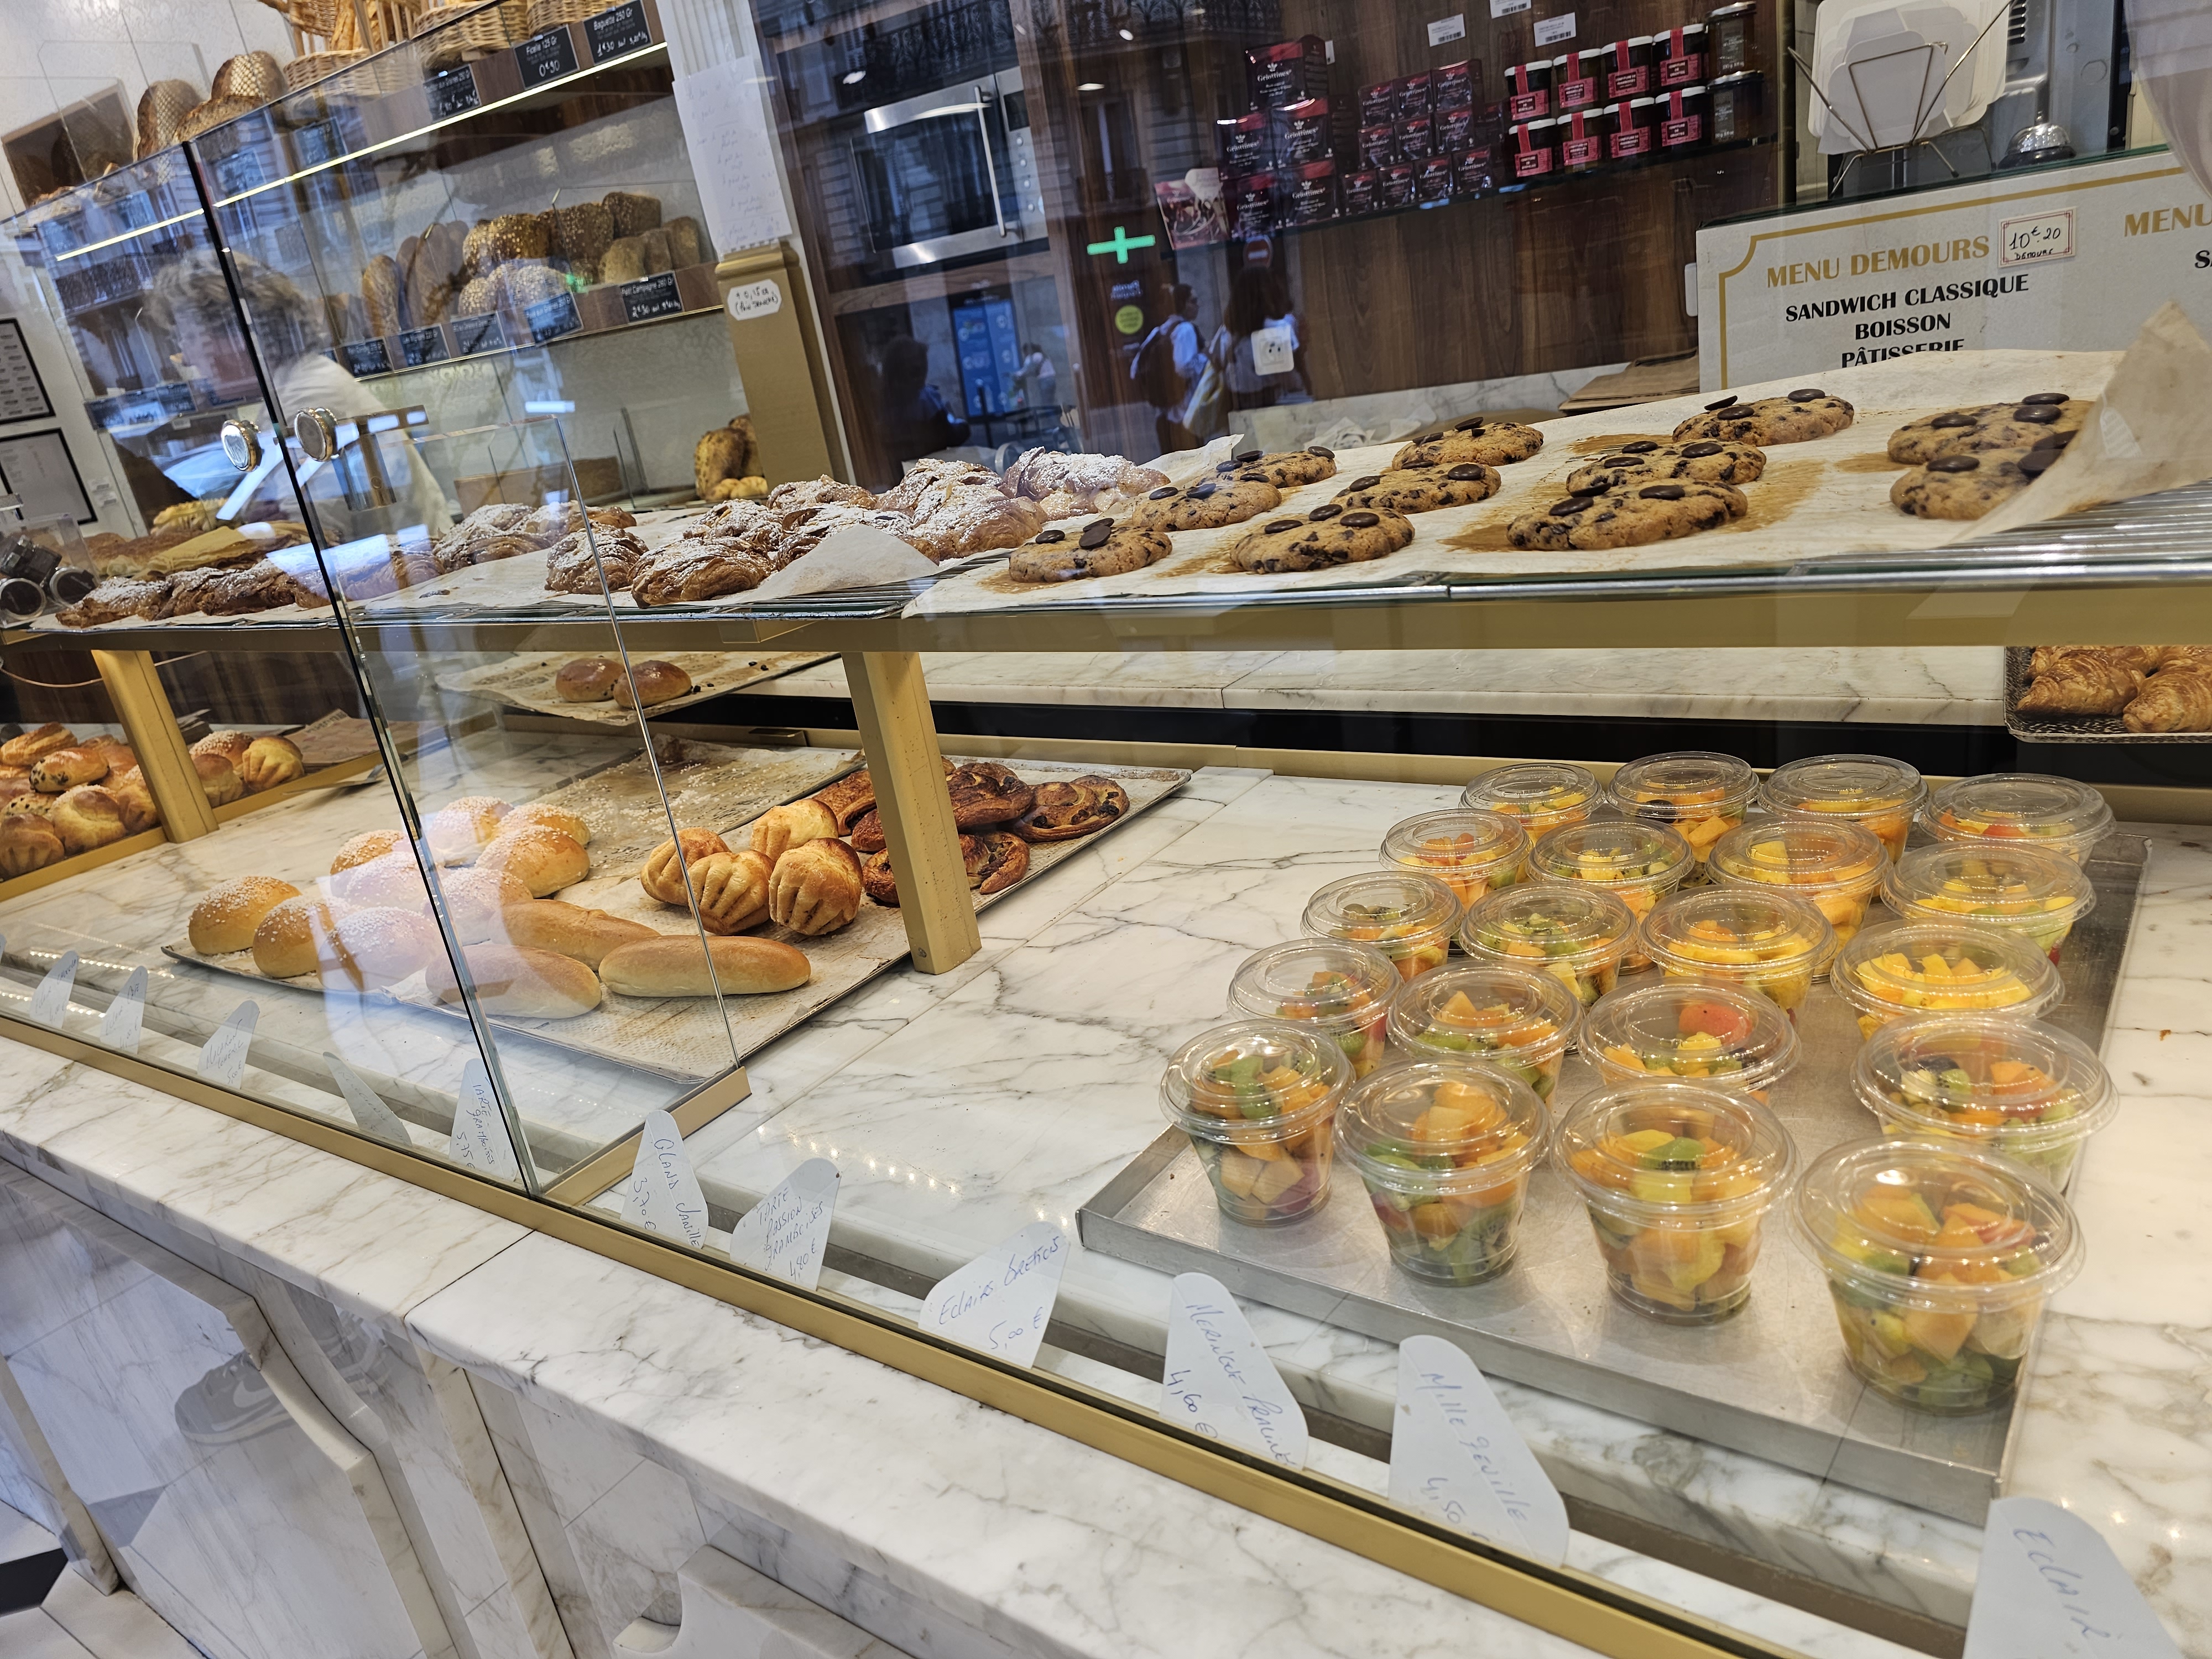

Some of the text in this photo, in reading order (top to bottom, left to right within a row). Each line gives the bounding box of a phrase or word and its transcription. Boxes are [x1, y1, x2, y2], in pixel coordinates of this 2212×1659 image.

[2124, 204, 2212, 237] MENU
[1767, 236, 1990, 288] MENU DEMOURS
[1786, 274, 2029, 322] SANDWICH CLASSIQUE
[1855, 312, 1951, 341] BOISSON
[757, 1187, 790, 1226] TARTE
[765, 1196, 802, 1244] PASSION
[644, 1220, 656, 1230] €
[811, 1238, 817, 1254] €
[989, 1306, 1043, 1350] 5,00 €
[1195, 1422, 1219, 1439] €
